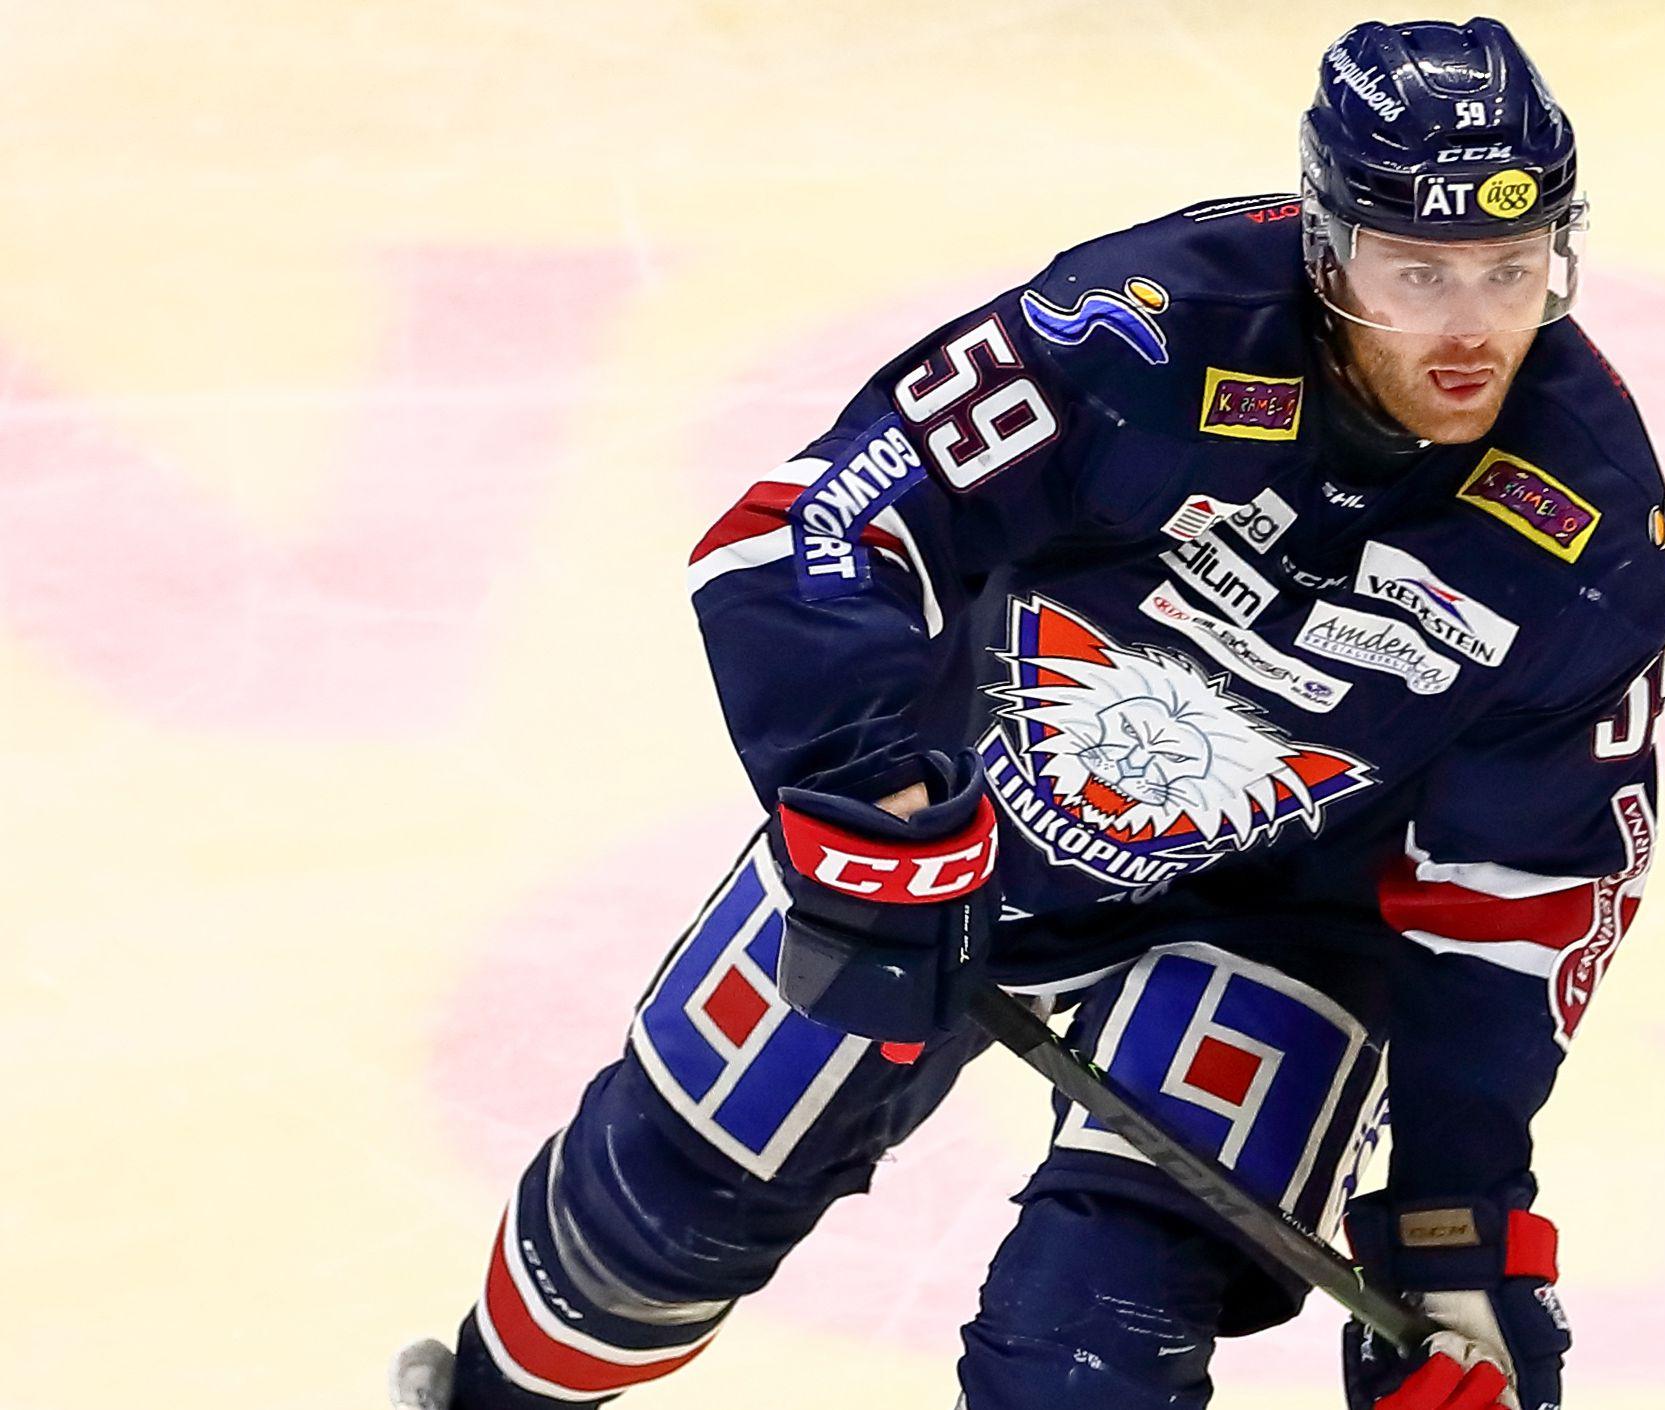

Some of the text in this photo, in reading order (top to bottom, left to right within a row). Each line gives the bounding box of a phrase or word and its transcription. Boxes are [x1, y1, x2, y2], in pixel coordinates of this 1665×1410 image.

[1455, 101, 1487, 129] 59
[1437, 146, 1513, 163] CCM
[1246, 205, 1301, 223] OTA
[1421, 177, 1532, 216] ÄT ägg
[893, 313, 1059, 492] 59
[803, 427, 922, 579] GOLVKORT
[1230, 502, 1280, 543] gg
[1171, 537, 1262, 617] dium
[987, 755, 1190, 882] LINKÖPING
